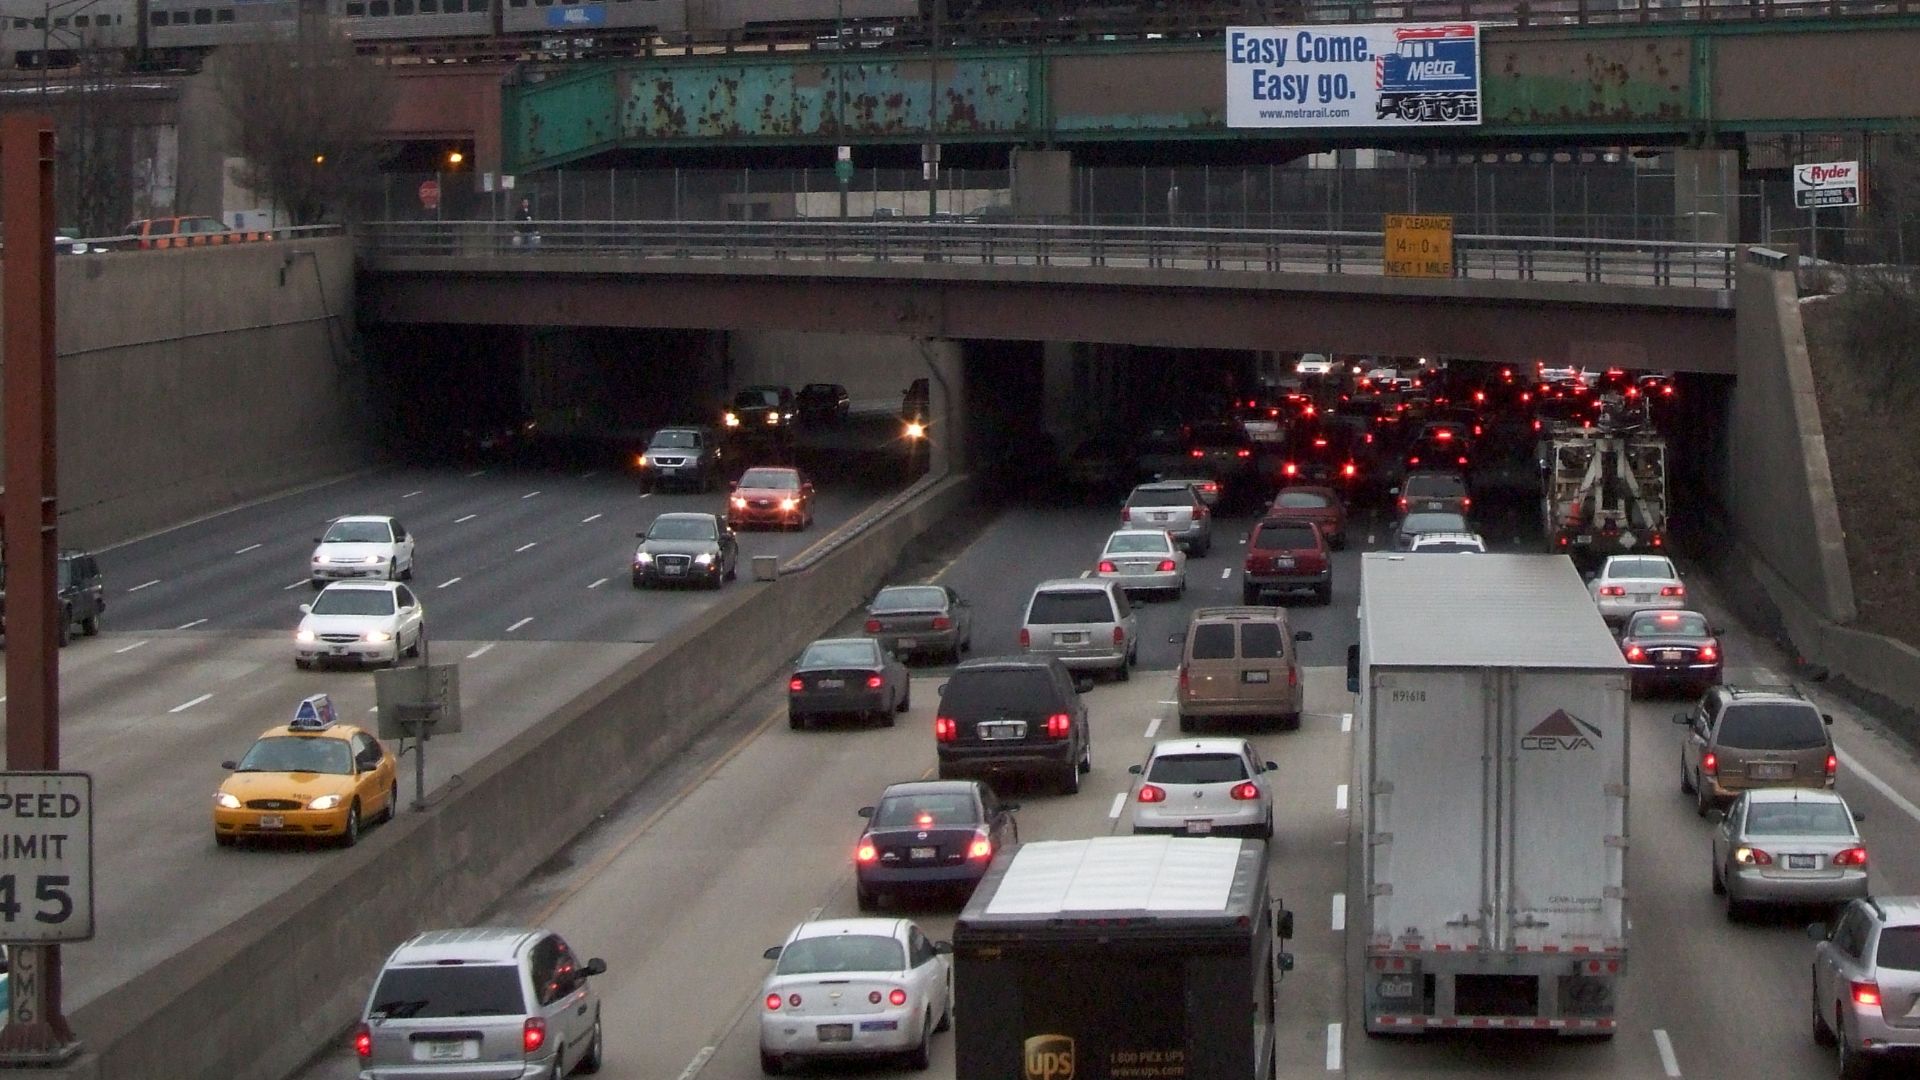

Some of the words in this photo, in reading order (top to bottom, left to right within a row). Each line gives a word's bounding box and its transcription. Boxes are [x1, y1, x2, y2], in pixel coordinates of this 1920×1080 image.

[1231, 32, 1288, 67] Easy
[1296, 31, 1376, 63] Come.
[1407, 60, 1456, 82] Metra
[1252, 69, 1309, 104] Easy
[1317, 73, 1356, 104] go.
[1259, 107, 1350, 119] www.metrarail.com
[1811, 165, 1851, 182] Ryder
[1405, 217, 1452, 231] CLEARANCE
[1396, 238, 1407, 253] 14
[1421, 239, 1430, 254] 0
[1386, 261, 1412, 274] NEXT
[1425, 261, 1450, 274] MILE
[1521, 736, 1595, 751] CEVA
[0, 793, 82, 819] PEED
[0, 834, 69, 860] IMIT
[1028, 1051, 1073, 1080] ups
